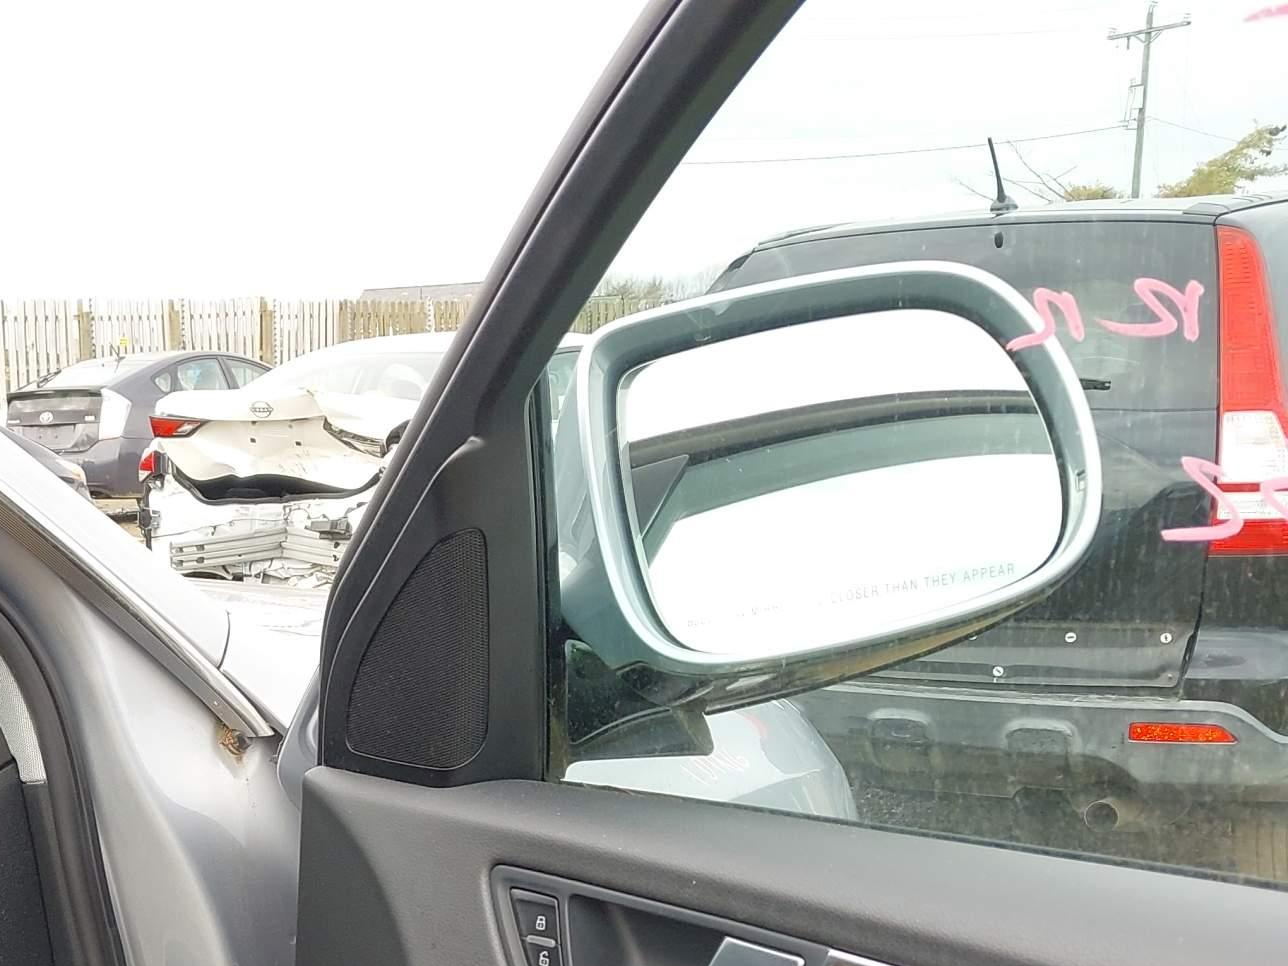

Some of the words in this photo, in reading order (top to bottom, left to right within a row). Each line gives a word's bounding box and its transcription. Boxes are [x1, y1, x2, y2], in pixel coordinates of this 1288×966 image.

[884, 579, 919, 595] THAN
[923, 571, 957, 590] THEY
[962, 562, 1016, 582] APPEAR
